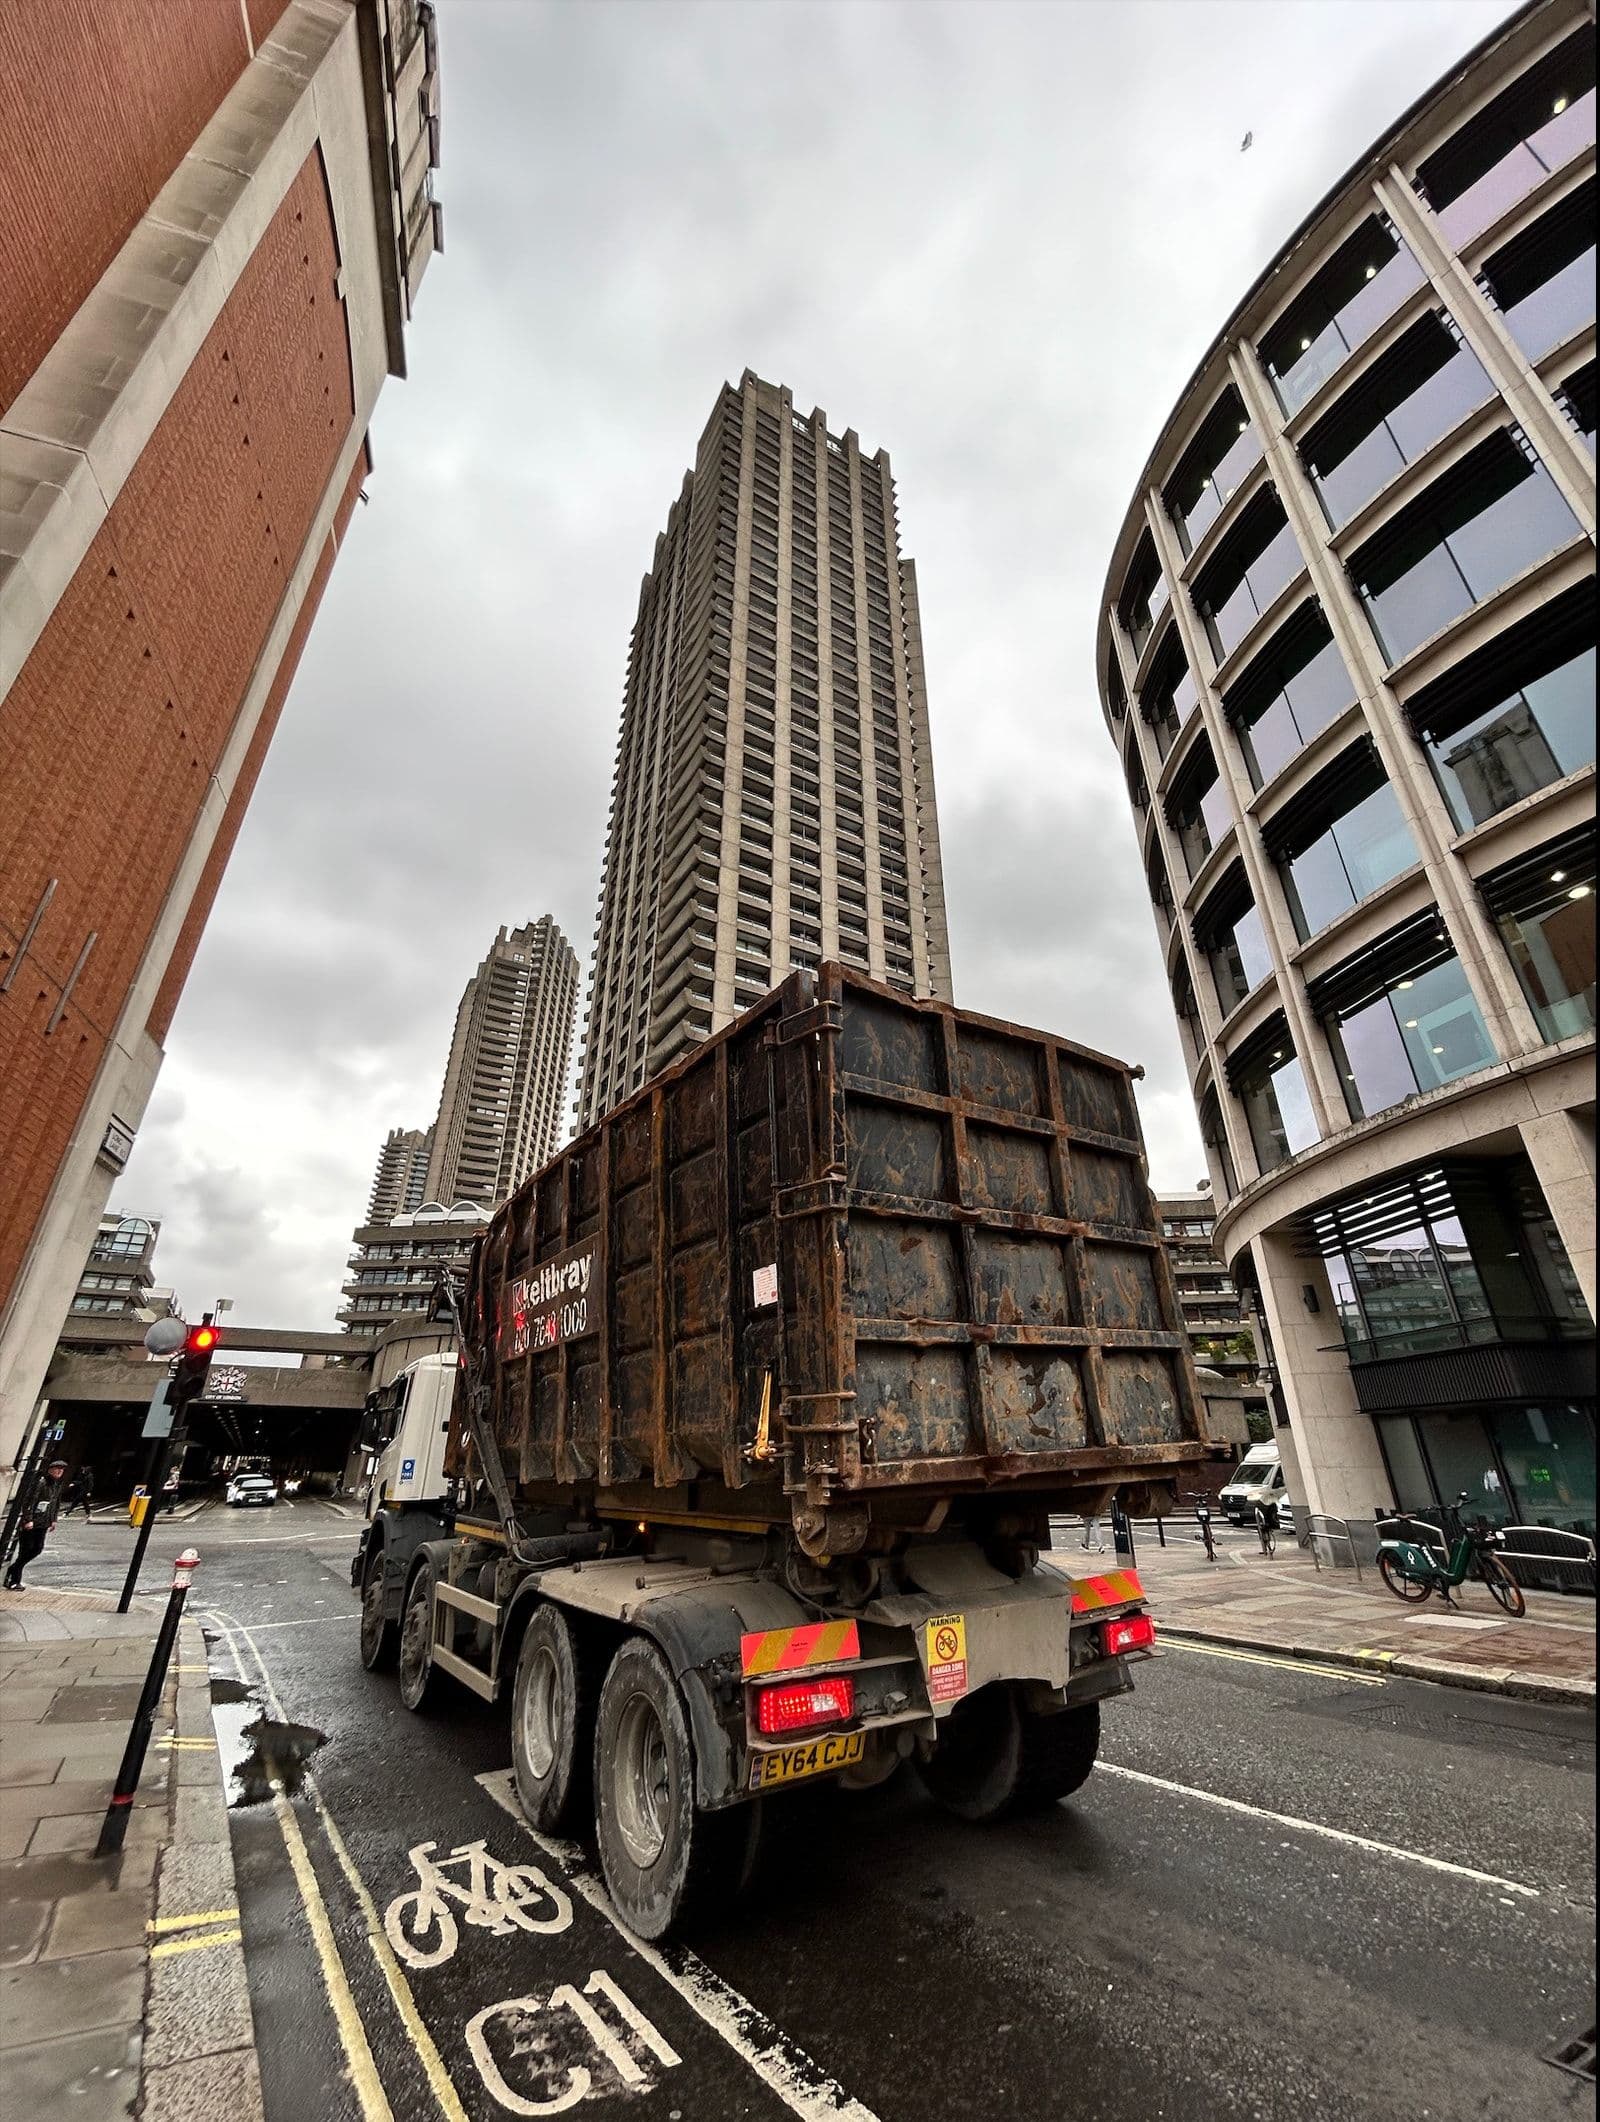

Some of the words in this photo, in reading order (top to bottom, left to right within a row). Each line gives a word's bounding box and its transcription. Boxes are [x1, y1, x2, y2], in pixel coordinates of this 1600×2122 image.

[523, 1253, 592, 1310] keltbray
[560, 1298, 587, 1338] 1000
[930, 1616, 961, 1628] WARNING
[932, 1663, 951, 1675] DANGER
[952, 1660, 964, 1671] ZONE
[765, 1746, 818, 1780] EY64
[823, 1736, 861, 1765] CJJ
[465, 1969, 682, 2116] C11
